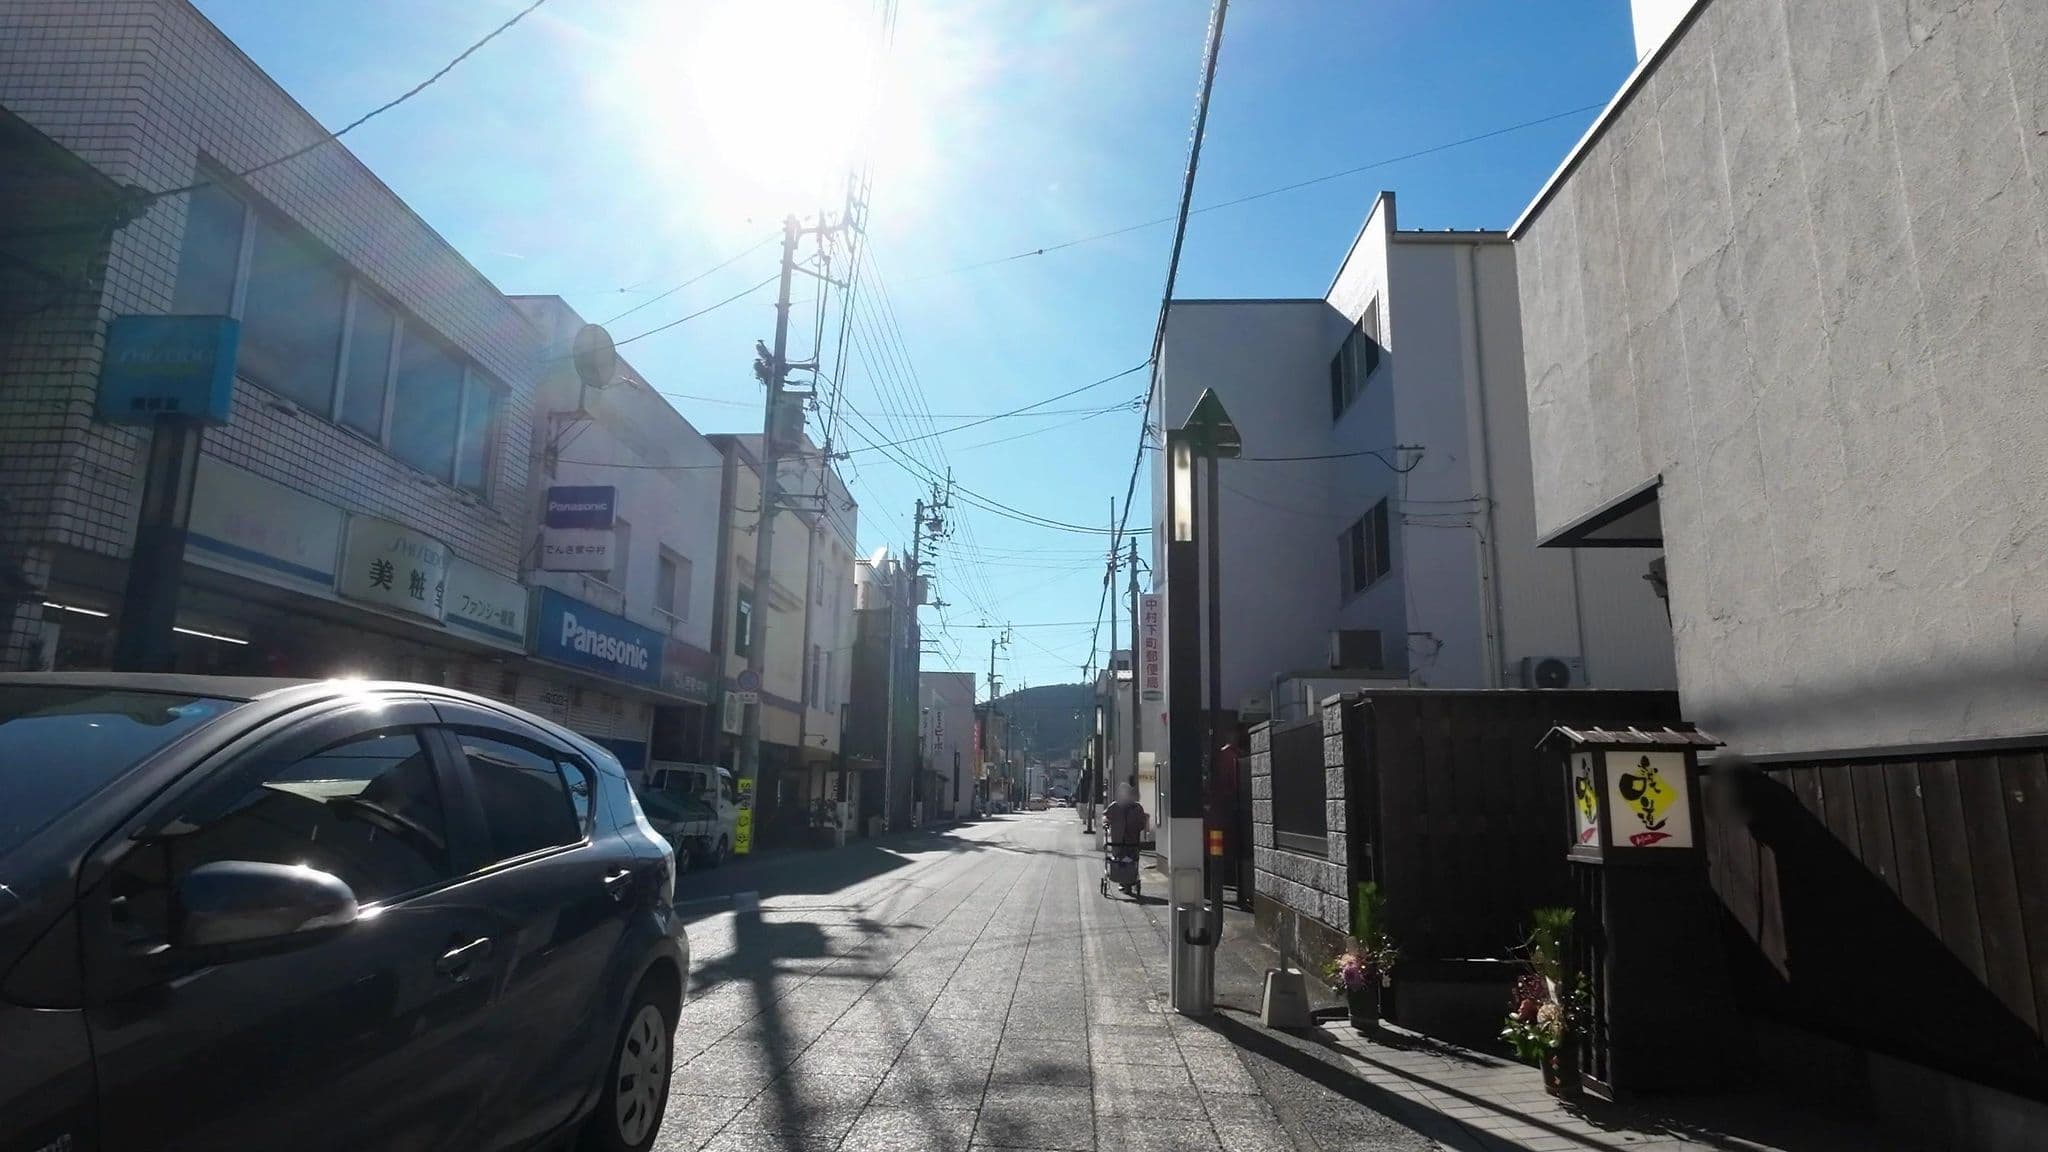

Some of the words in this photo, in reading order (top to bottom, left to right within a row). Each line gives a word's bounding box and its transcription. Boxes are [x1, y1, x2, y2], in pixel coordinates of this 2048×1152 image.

[550, 502, 607, 511] Panasonic
[561, 611, 648, 670] Panasonic
[1145, 599, 1159, 689] 中村下町郵便局
